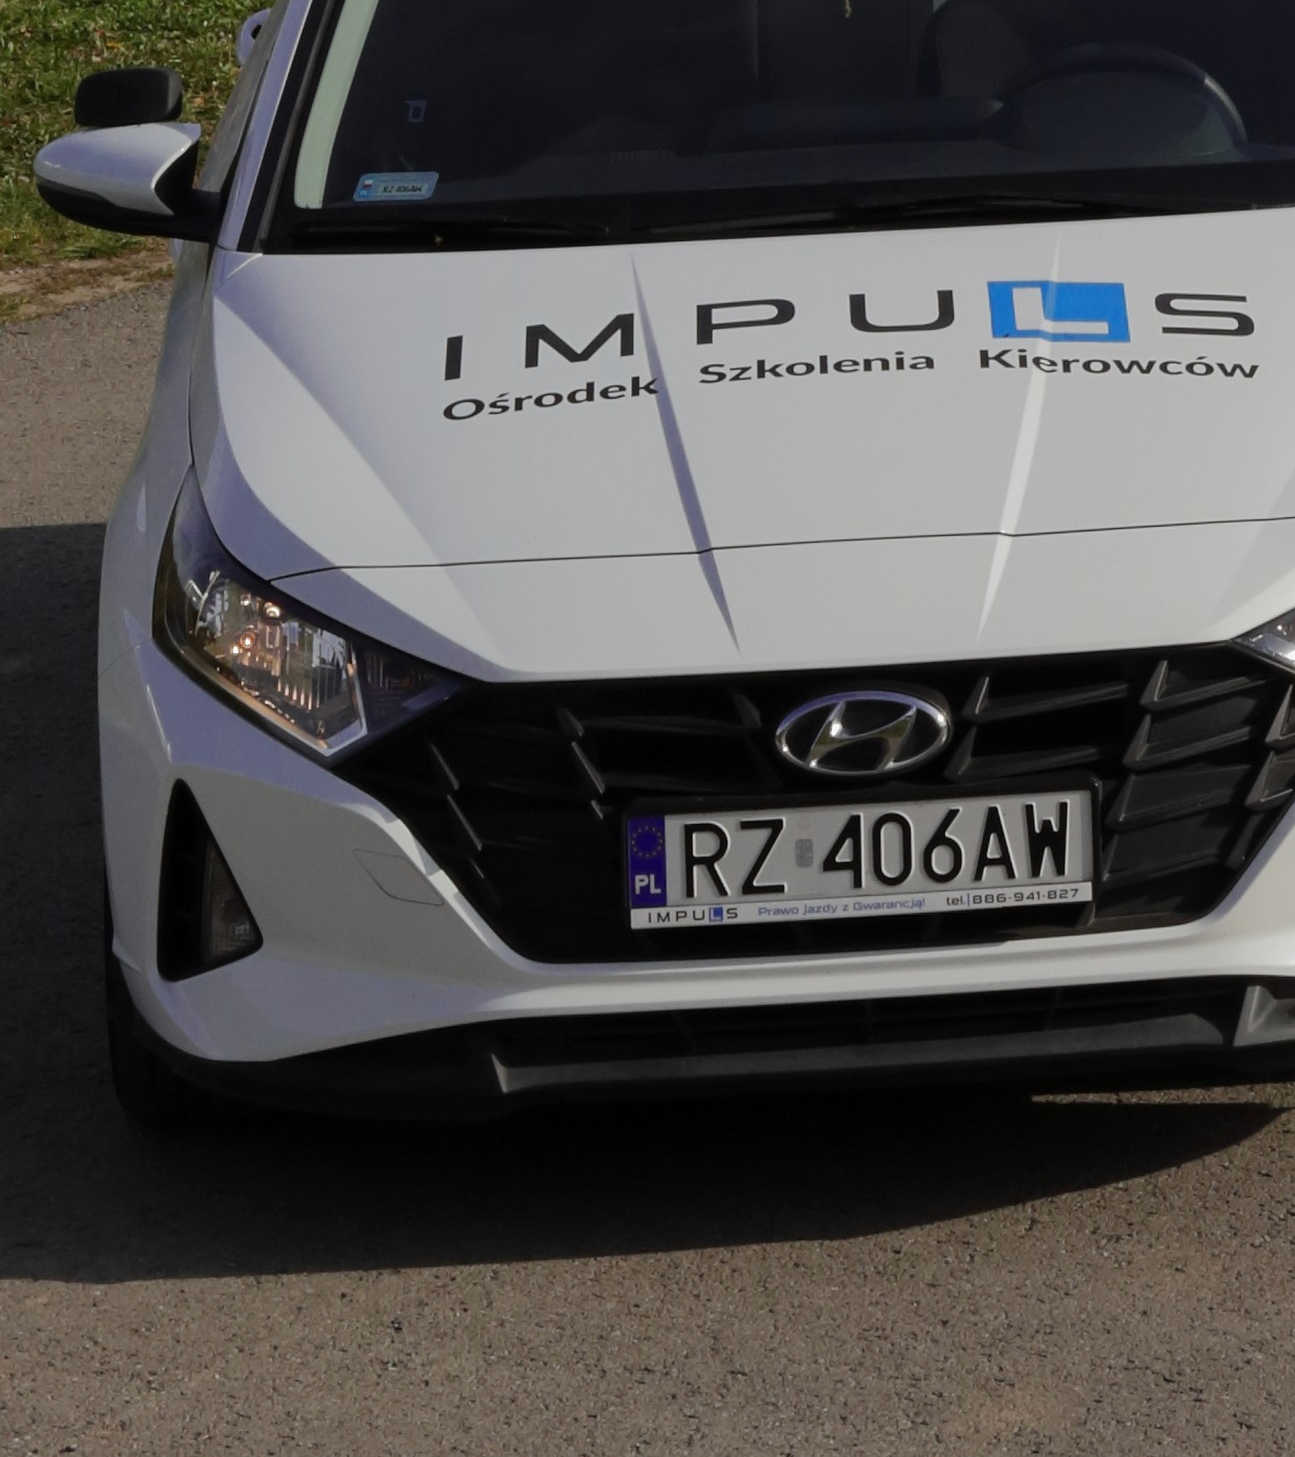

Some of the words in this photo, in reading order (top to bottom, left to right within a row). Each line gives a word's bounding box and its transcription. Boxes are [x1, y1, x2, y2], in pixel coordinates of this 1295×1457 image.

[443, 286, 1256, 381] IMPULS
[442, 376, 659, 421] Ośrodek
[698, 352, 935, 384] Szkolenia
[979, 349, 1260, 379] Kierowców
[684, 818, 787, 899] RZ
[823, 801, 1069, 889] 406AW
[634, 873, 661, 895] PL
[758, 907, 799, 917] Prawo
[802, 903, 838, 915] jazdy
[842, 904, 849, 912] z
[853, 898, 926, 911] Gwarancją!
[648, 907, 738, 924] IMPULS
